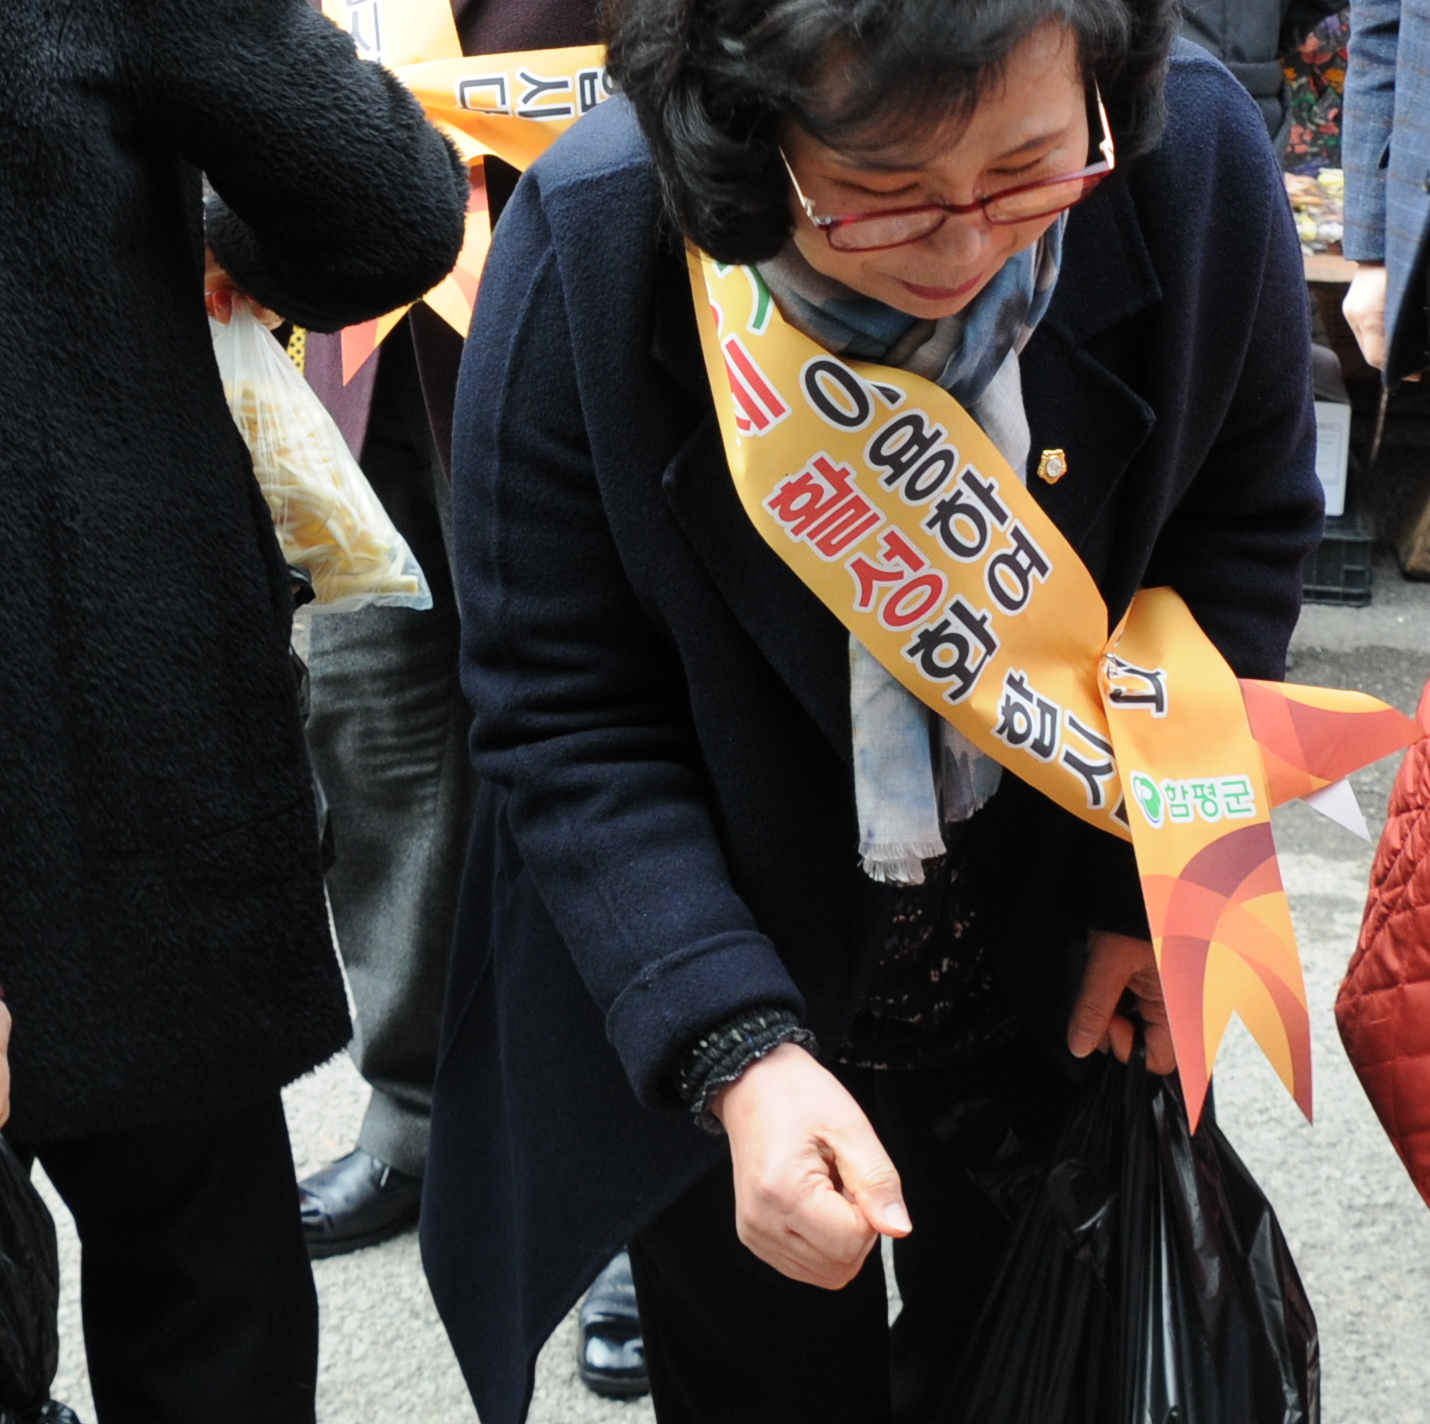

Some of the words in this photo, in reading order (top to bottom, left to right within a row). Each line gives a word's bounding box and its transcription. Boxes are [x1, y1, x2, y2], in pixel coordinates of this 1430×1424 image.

[767, 454, 1001, 705] 활성화
[992, 671, 1133, 836] 합시
[1165, 776, 1255, 821] 함평군
